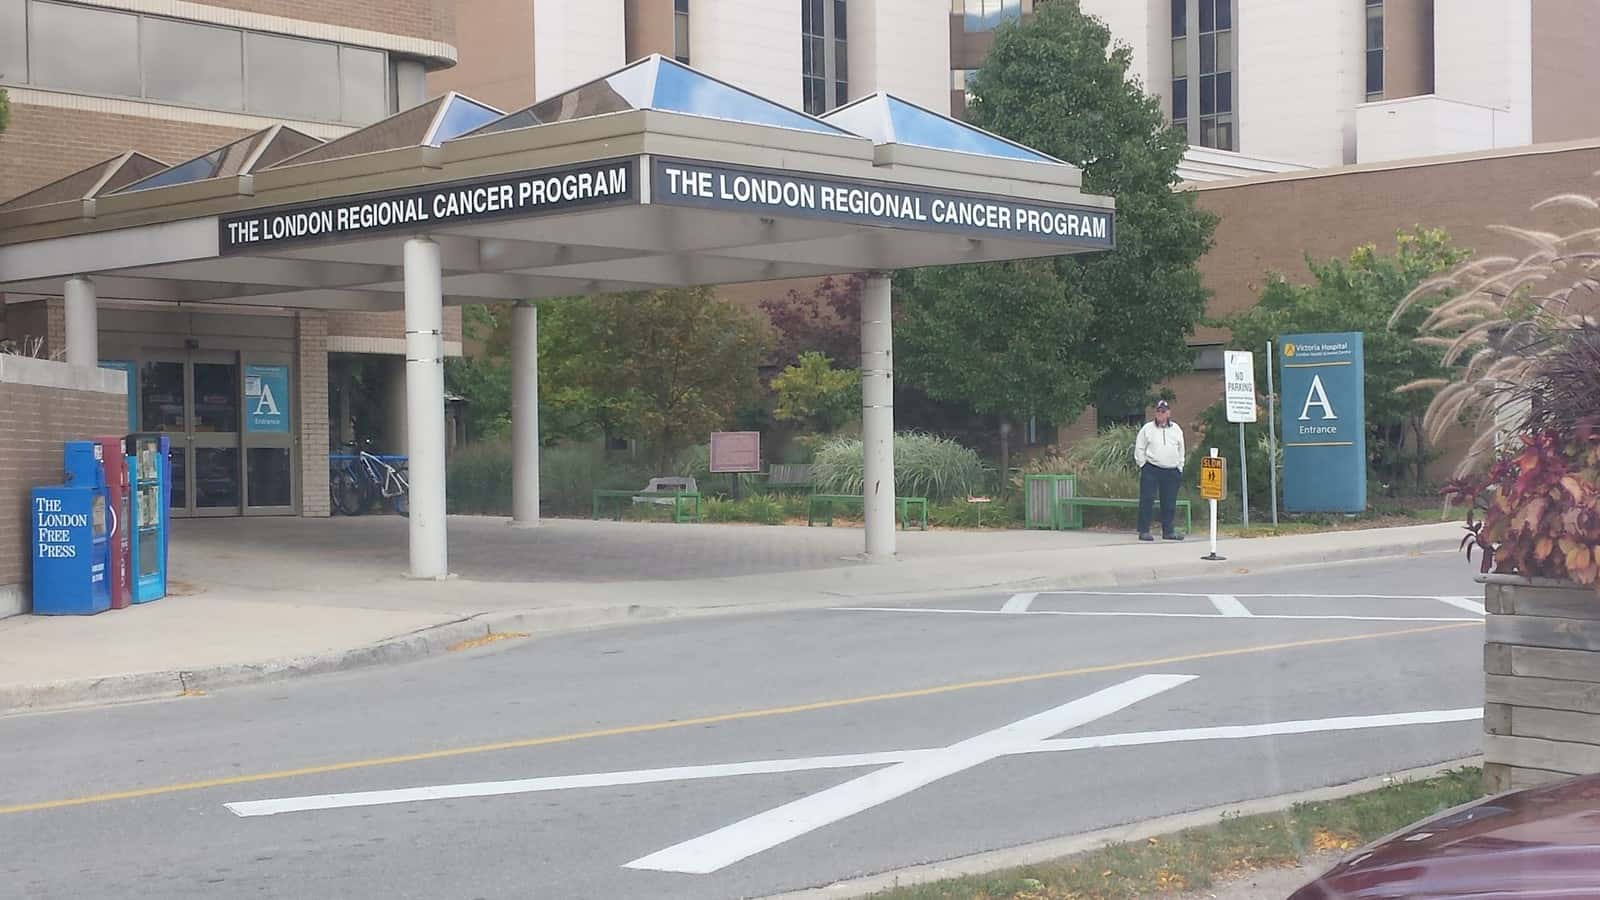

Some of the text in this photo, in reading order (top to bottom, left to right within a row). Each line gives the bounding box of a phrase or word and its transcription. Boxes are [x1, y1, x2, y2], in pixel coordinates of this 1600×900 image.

[228, 167, 627, 244] THE LONDON REGIONAL CANCER PROGRAM
[665, 168, 1106, 239] THE LONDON REGIONAL CANCER PROGRAM
[1296, 341, 1348, 353] Victoria Hospital
[1235, 371, 1244, 381] NO
[1227, 382, 1253, 393] PARKING
[253, 383, 281, 415] A
[1298, 374, 1338, 421] A
[1299, 425, 1337, 434] Entrance
[36, 497, 62, 512] THE
[38, 512, 88, 527] LONDON
[39, 527, 70, 542] FREE
[39, 543, 77, 558] PRESS
